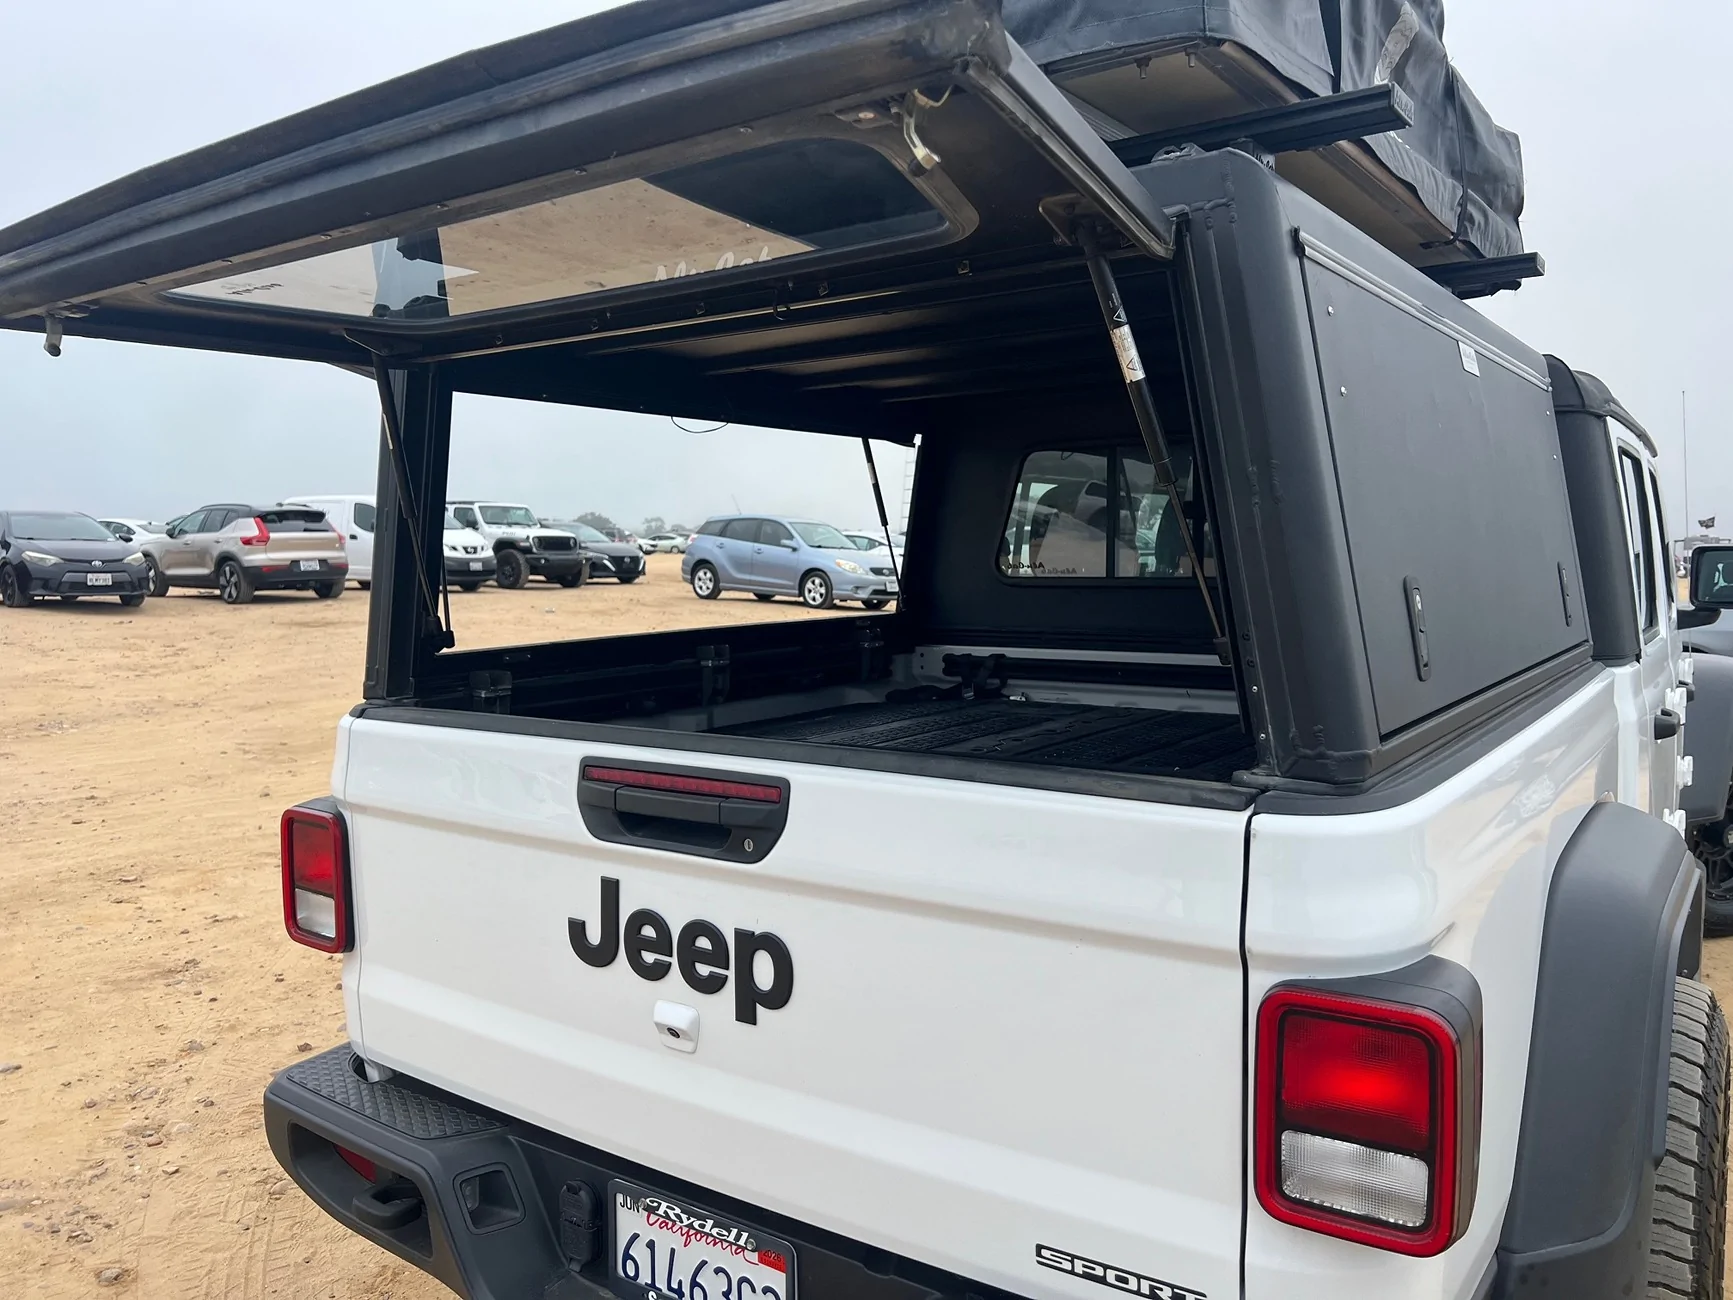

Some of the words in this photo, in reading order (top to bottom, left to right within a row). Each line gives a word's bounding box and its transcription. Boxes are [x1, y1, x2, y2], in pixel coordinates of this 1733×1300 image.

[568, 876, 793, 1025] Jeep
[619, 1194, 640, 1213] JUN
[646, 1197, 749, 1247] Rydell
[762, 1249, 782, 1263] 2026
